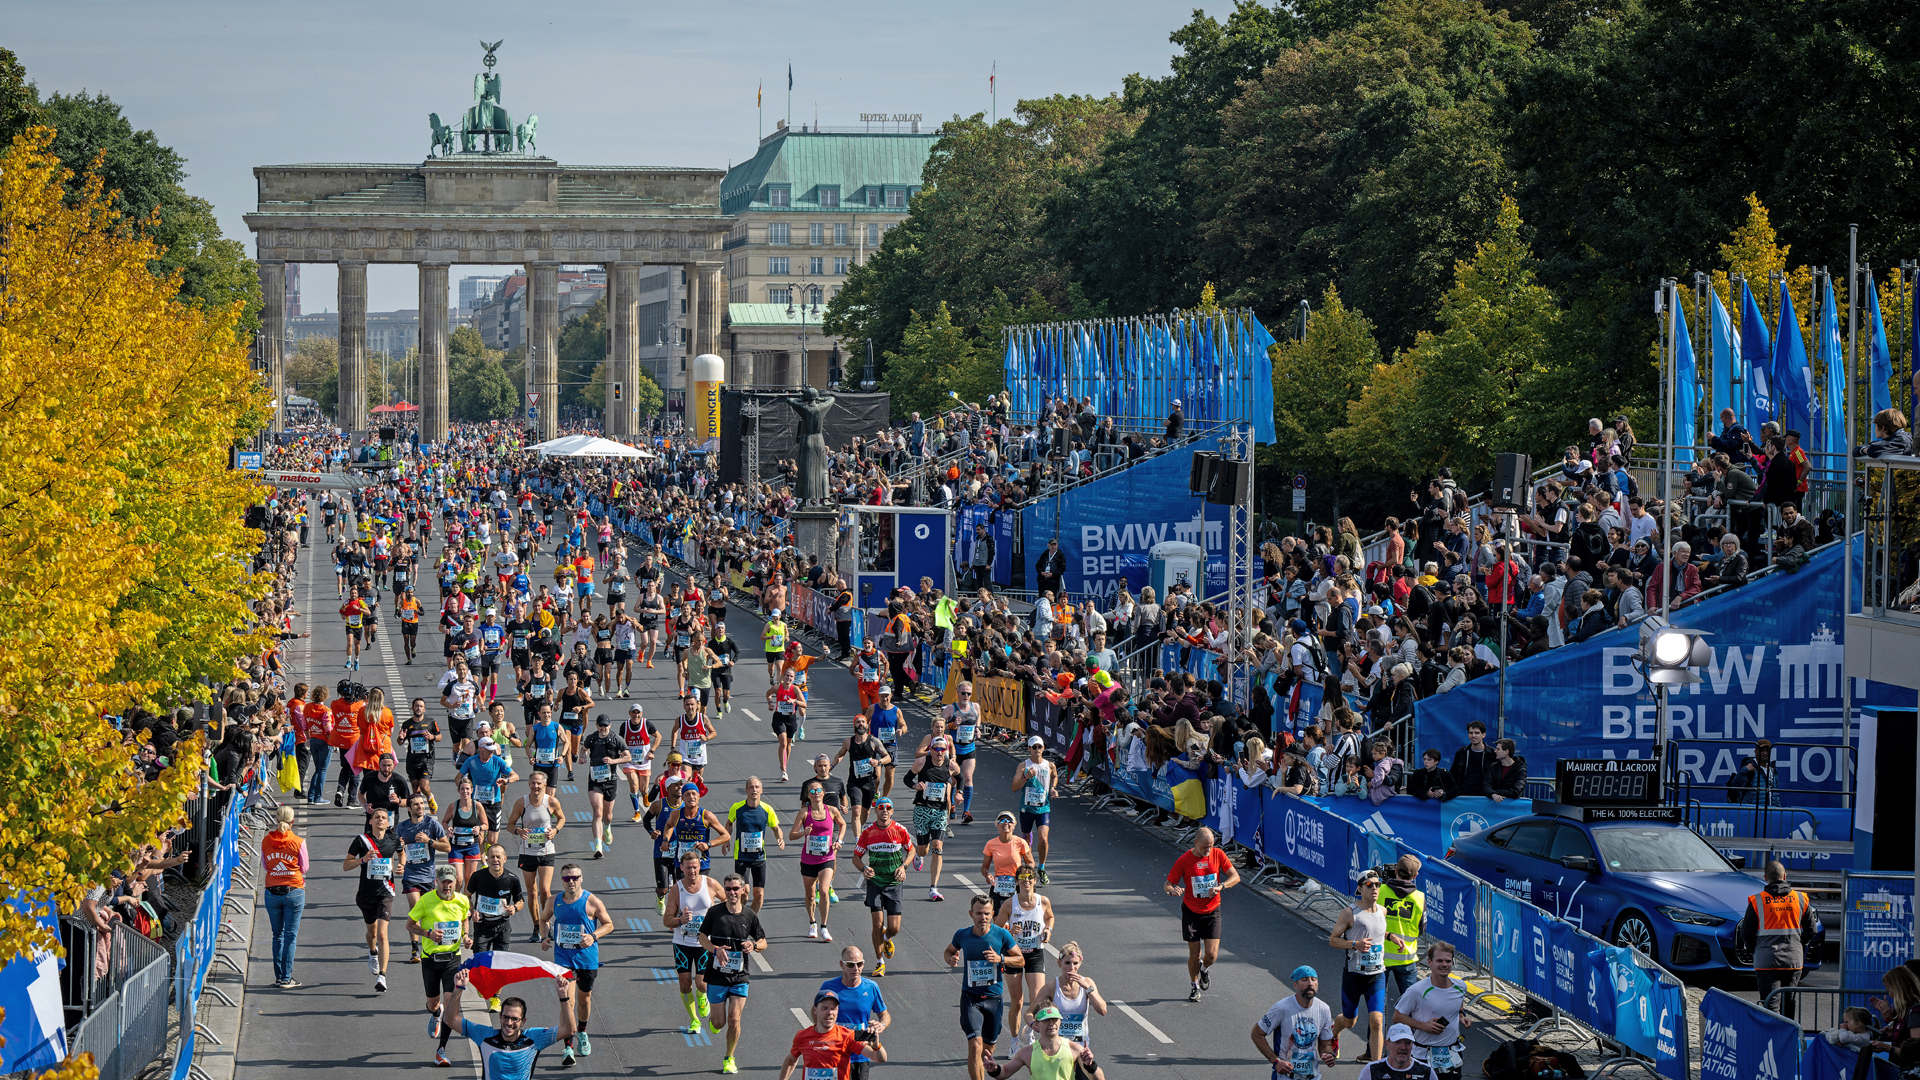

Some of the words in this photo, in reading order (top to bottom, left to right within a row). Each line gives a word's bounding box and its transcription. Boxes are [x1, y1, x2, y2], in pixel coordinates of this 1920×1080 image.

[860, 113, 889, 121] HOTEL
[892, 113, 922, 121] ADLON
[707, 388, 717, 440] ERDINGER
[279, 474, 321, 484] mateco
[1081, 523, 1168, 552] BMW
[1602, 703, 1765, 740] BERLIN
[1566, 761, 1603, 772] MAURICE
[1620, 761, 1657, 772] LACROIX
[1456, 814, 1485, 826] BMW
[1592, 810, 1606, 818] THE
[1619, 810, 1638, 818] 100%
[1639, 810, 1675, 818] ELECTRIC.
[1296, 813, 1324, 848] 万达体育
[266, 852, 294, 863] BERLIN
[1297, 843, 1311, 862] WANDA
[1311, 849, 1325, 868] SPORTS
[1425, 878, 1438, 899] BMW
[1505, 878, 1522, 891] BMW
[1426, 895, 1438, 910] BERLIN
[1542, 890, 1554, 902] THE
[1452, 919, 1468, 937] adidas
[1016, 935, 1034, 944] 22120
[970, 967, 992, 976] 15868
[1059, 1022, 1083, 1030] 59868
[1704, 1019, 1725, 1043] MW
[1703, 1040, 1725, 1058] RLIN
